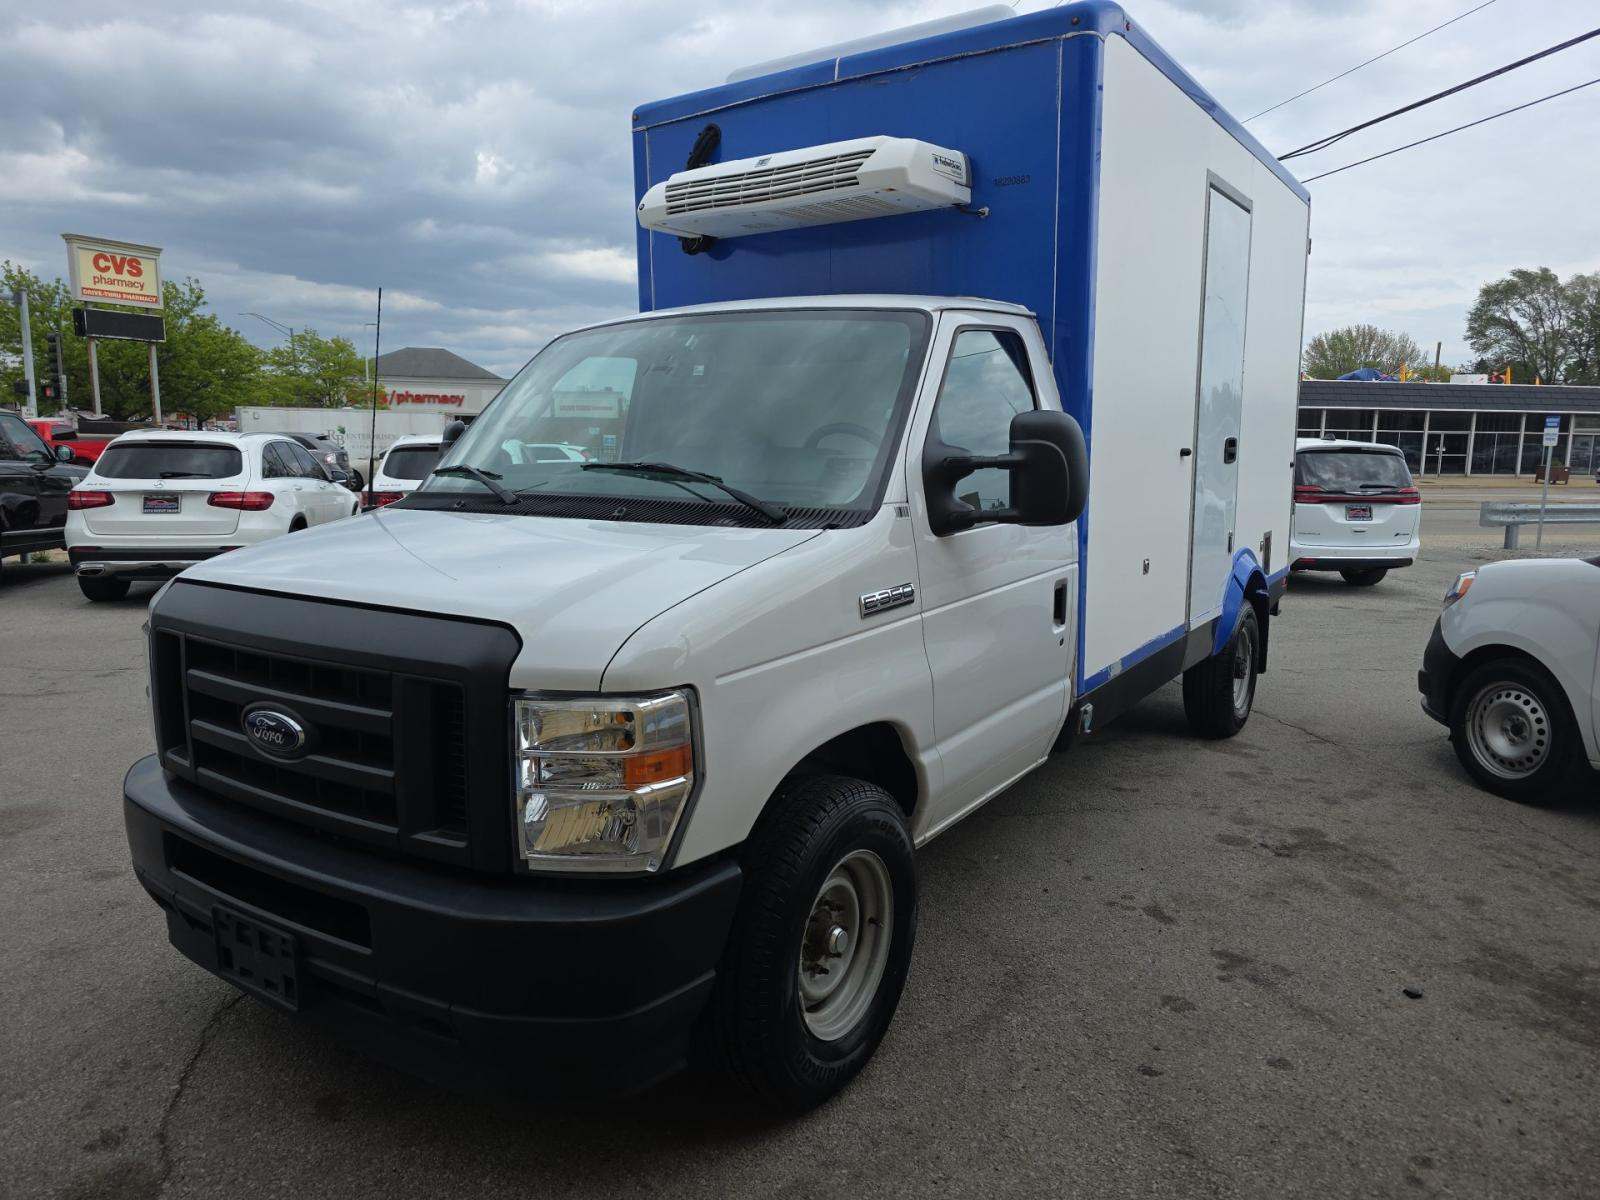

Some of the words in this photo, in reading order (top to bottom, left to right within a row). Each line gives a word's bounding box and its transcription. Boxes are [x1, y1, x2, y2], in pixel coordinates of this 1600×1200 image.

[92, 253, 144, 278] CVS
[92, 274, 145, 292] pharmacy
[375, 389, 465, 407] /pharmacy
[254, 717, 285, 745] Ford
